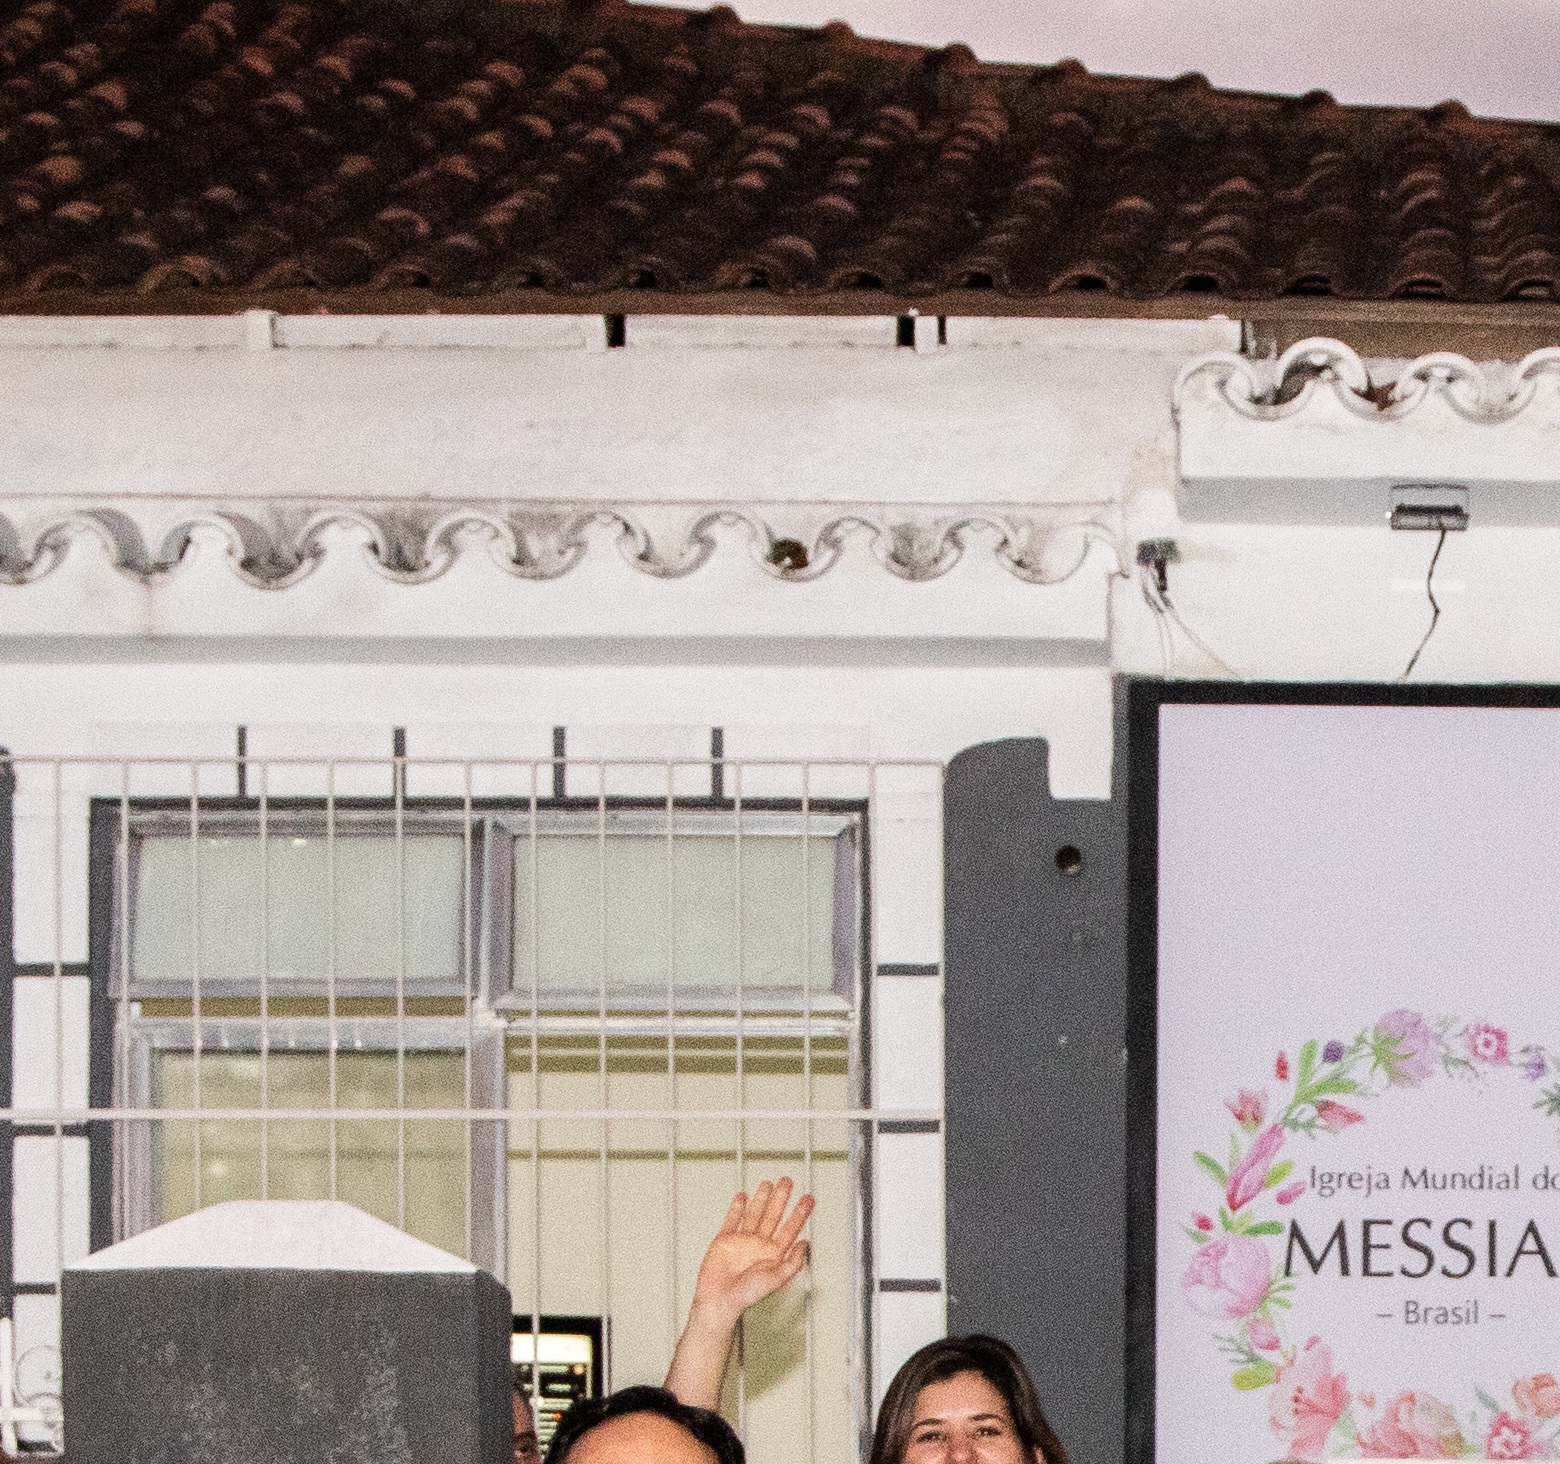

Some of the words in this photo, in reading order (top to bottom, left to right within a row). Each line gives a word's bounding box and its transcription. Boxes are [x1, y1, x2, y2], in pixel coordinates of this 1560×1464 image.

[1310, 1165, 1391, 1198] Igreja
[1401, 1165, 1520, 1191] Mundial
[1403, 1300, 1479, 1326] Brasil
